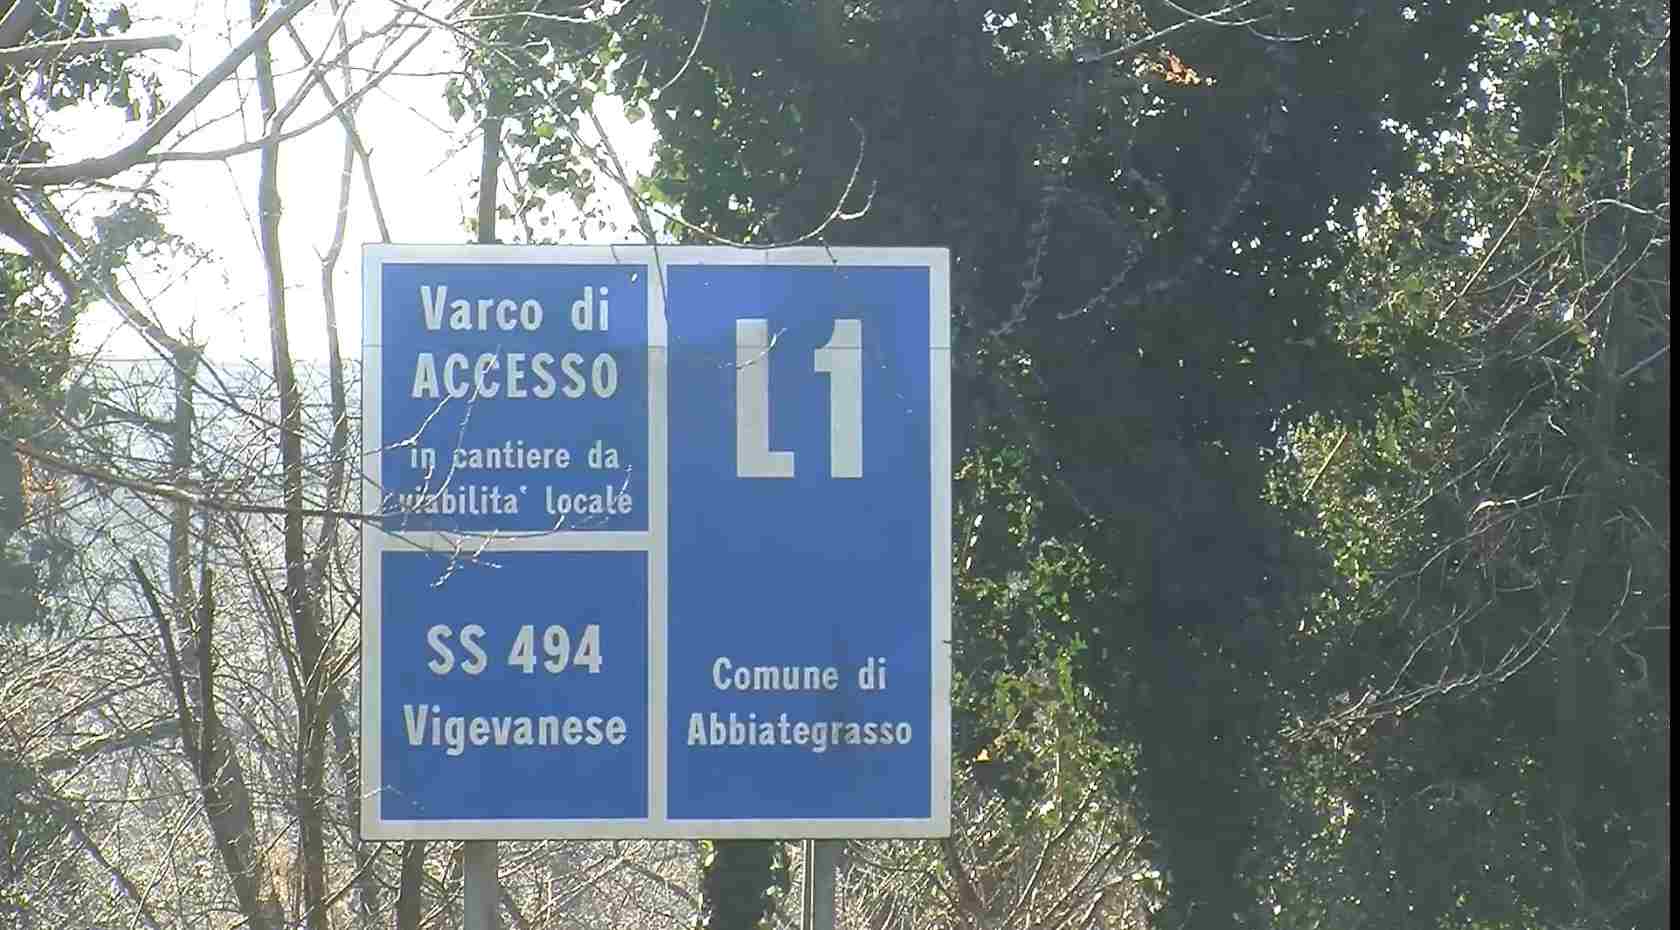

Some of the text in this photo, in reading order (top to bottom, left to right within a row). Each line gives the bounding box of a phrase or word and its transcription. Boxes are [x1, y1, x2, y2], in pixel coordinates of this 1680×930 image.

[420, 285, 609, 331] Varco di
[411, 352, 618, 399] ACCESSO
[735, 318, 863, 478] L1
[411, 440, 619, 469] in cantiere da
[546, 485, 632, 514] locale
[427, 624, 603, 675] SS 494
[712, 656, 887, 691] Comune di
[403, 704, 627, 756] Vigevanese
[687, 712, 912, 753] Abbiategrasso
